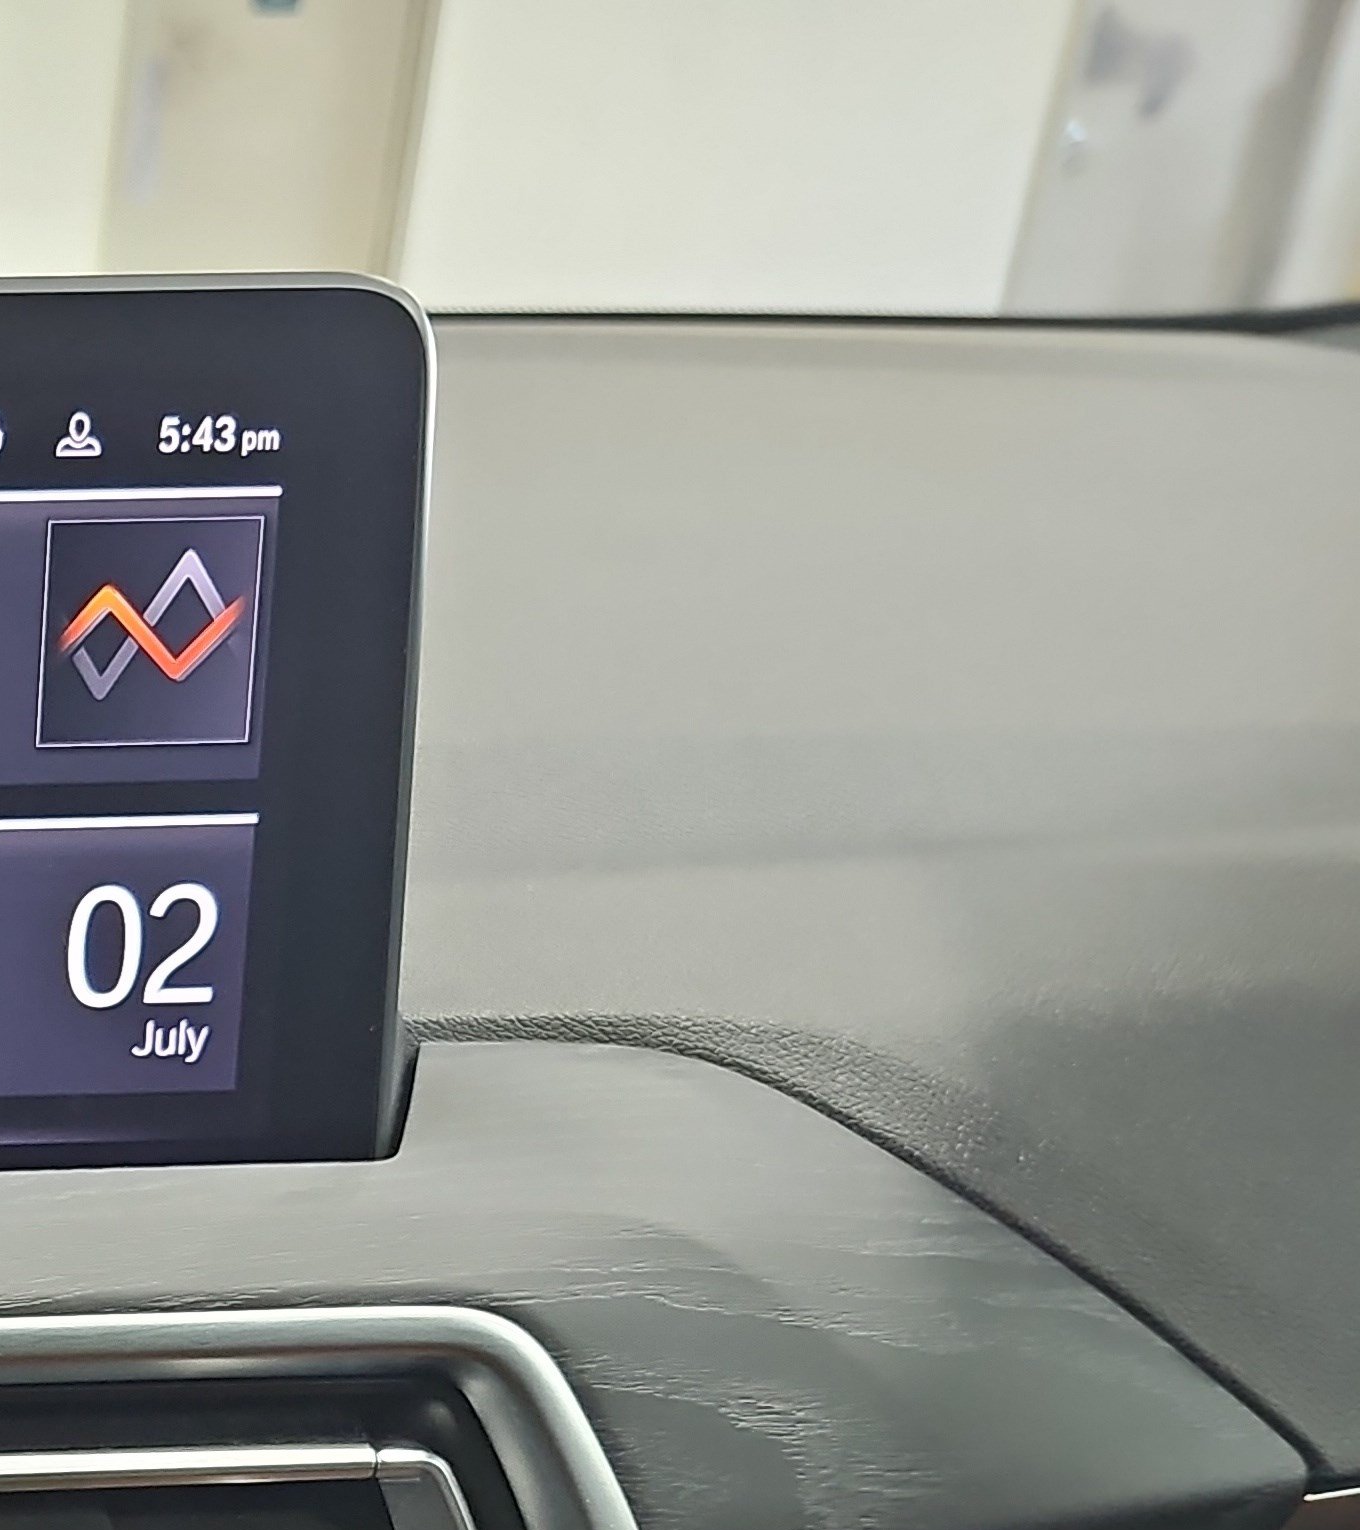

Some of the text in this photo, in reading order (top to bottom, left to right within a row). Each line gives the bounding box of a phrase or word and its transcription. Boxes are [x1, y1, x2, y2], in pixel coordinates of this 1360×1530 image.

[158, 414, 281, 457] 5:43 pm
[65, 882, 220, 1009] 02
[130, 1020, 209, 1064] July
